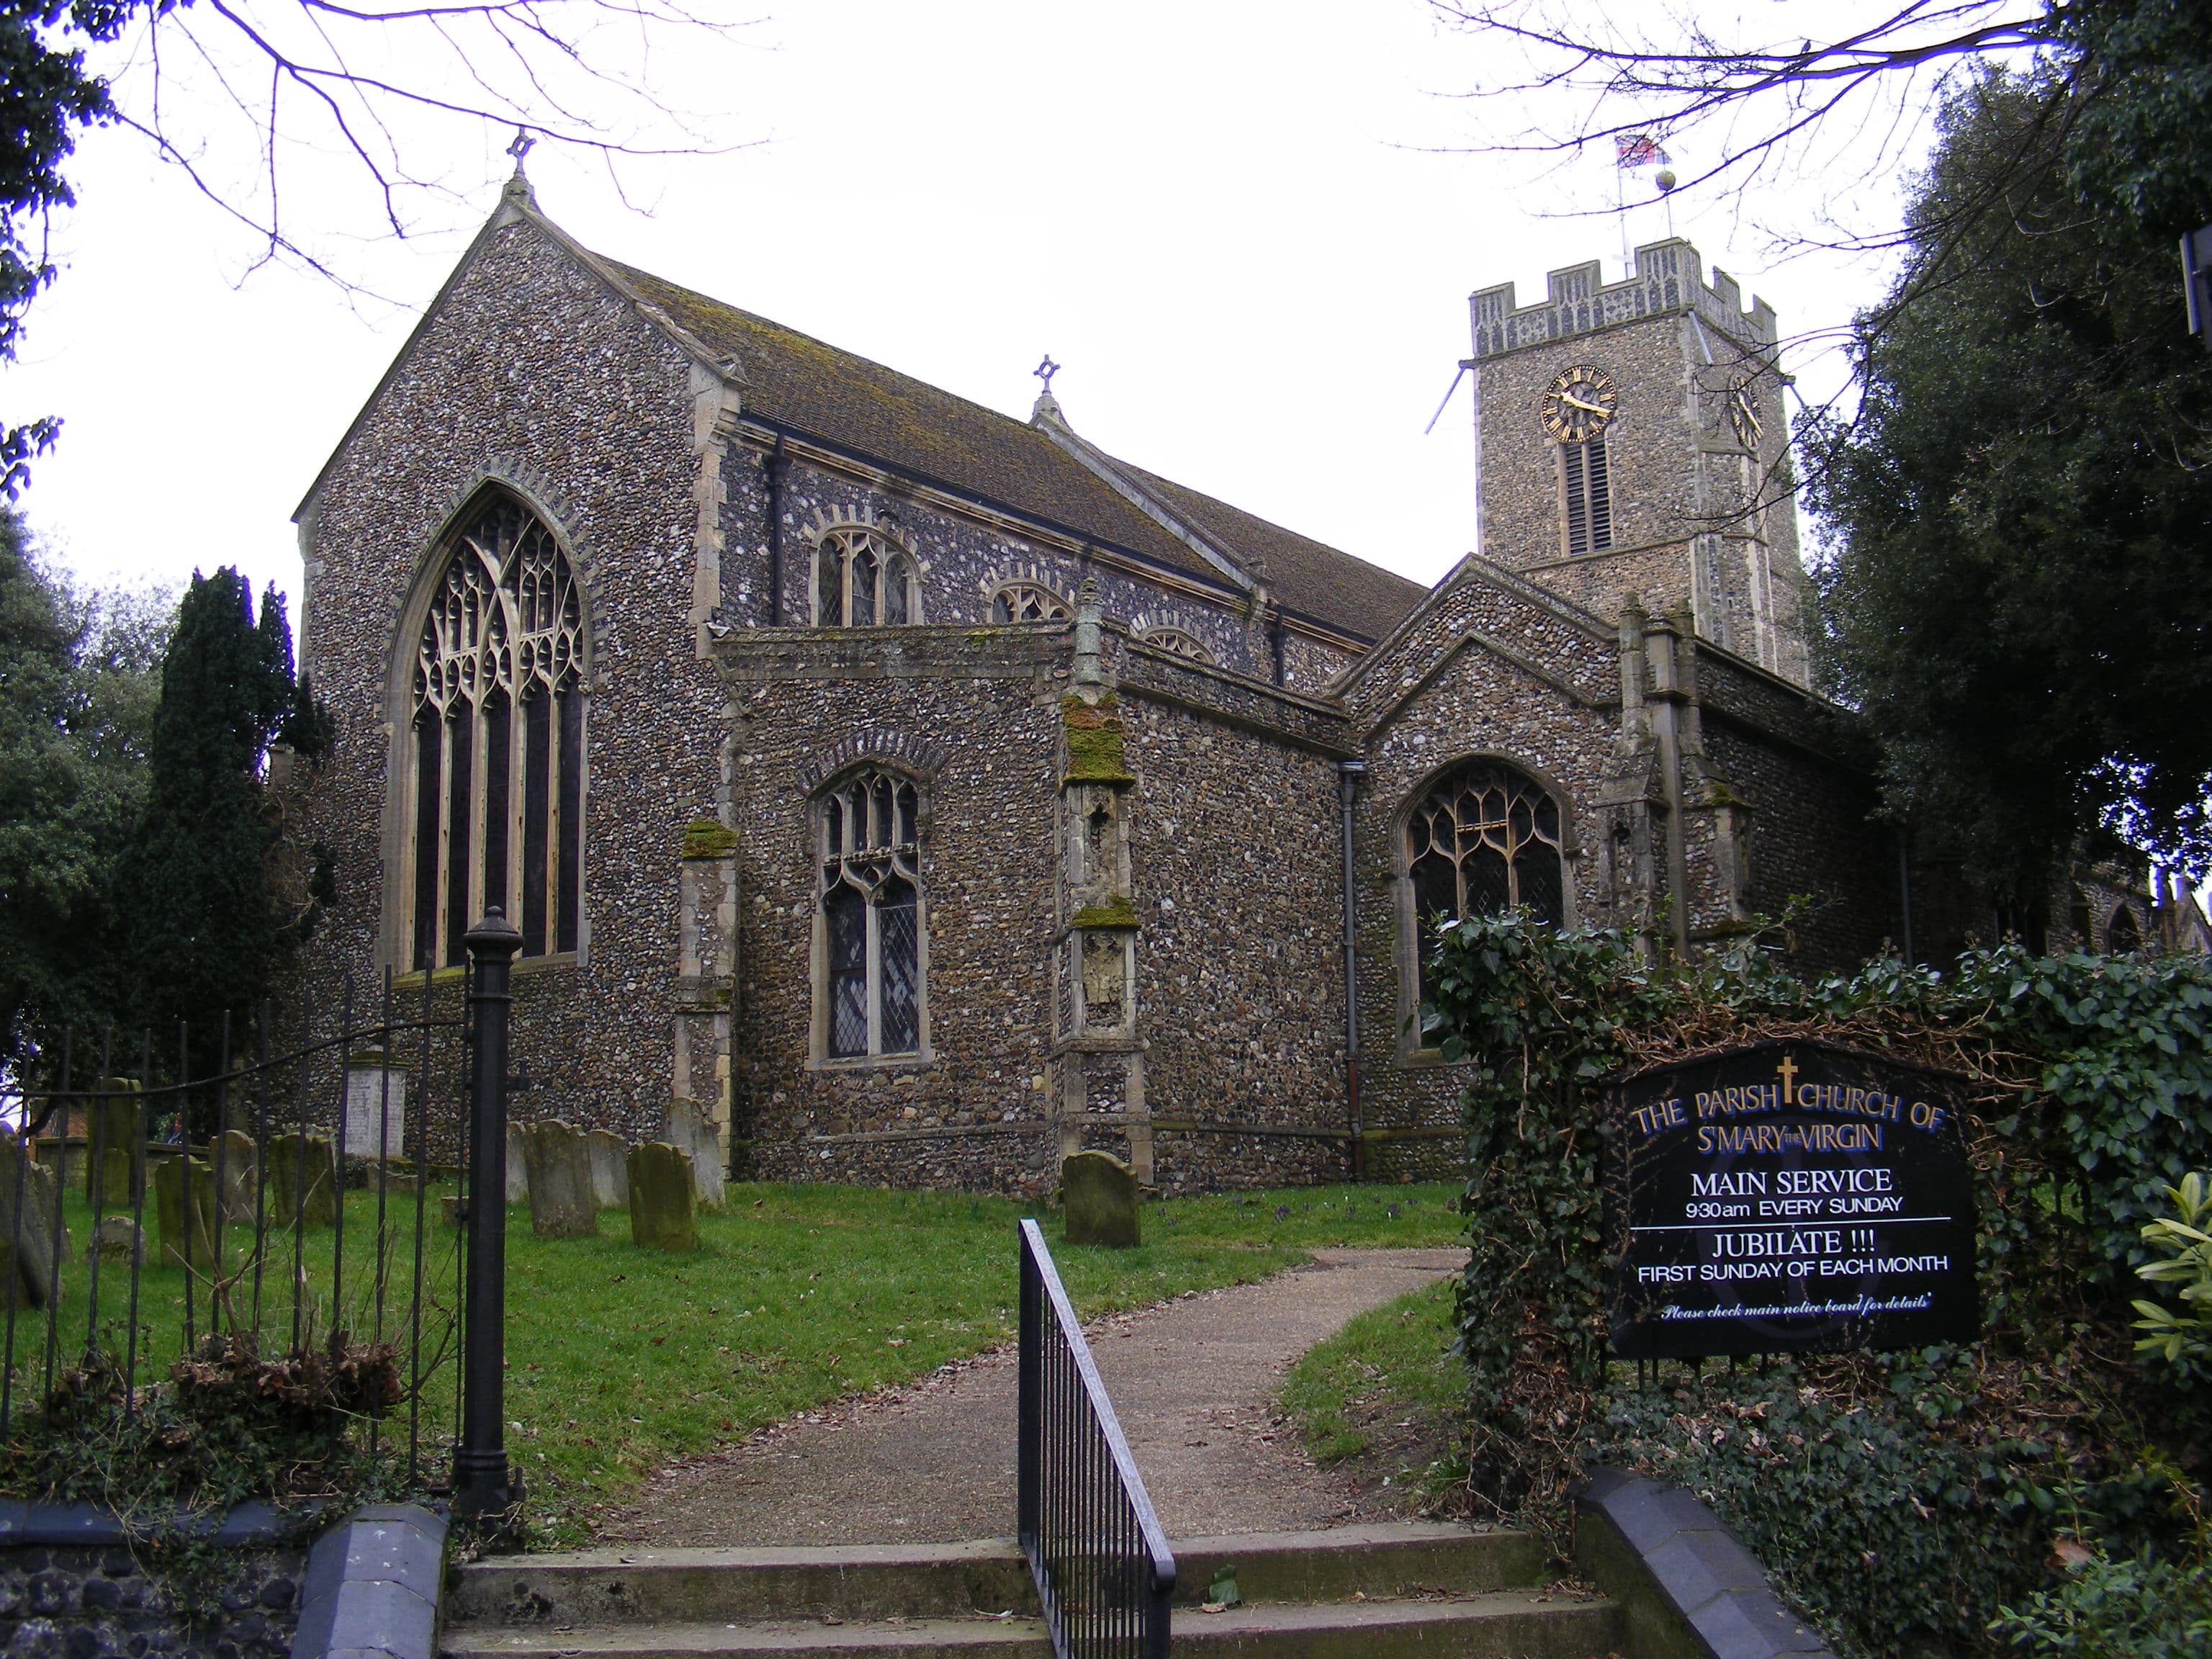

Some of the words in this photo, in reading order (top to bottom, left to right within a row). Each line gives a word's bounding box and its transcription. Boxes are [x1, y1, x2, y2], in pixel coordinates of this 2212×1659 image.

[1631, 1098, 1686, 1134] THE
[1694, 1084, 1779, 1118] PARISH
[1797, 1083, 1900, 1120] CHURCH
[1910, 1102, 1945, 1130] OF
[1717, 1125, 1787, 1151] MARY
[1783, 1133, 1802, 1144] THE
[1797, 1123, 1881, 1150] VIRGIN
[1690, 1171, 1768, 1197] MAIN
[1776, 1168, 1893, 1195] SERVICE
[1759, 1199, 1823, 1216] EVERY
[1829, 1196, 1903, 1214] SUNDAY
[1712, 1230, 1843, 1258] JUBILATE
[1851, 1228, 1876, 1253] !!!
[1637, 1265, 1696, 1283] FIRST
[1699, 1262, 1783, 1281] SUNDAY
[1786, 1260, 1816, 1277] OF
[1820, 1259, 1874, 1276] EACH
[1877, 1255, 1948, 1274] MONTH
[1660, 1304, 1706, 1320] Please
[1707, 1303, 1742, 1317] check
[1744, 1303, 1780, 1316] main
[1783, 1300, 1822, 1314] notice
[1824, 1294, 1863, 1313] board
[1860, 1296, 1883, 1316] for
[1884, 1295, 1928, 1310] details
